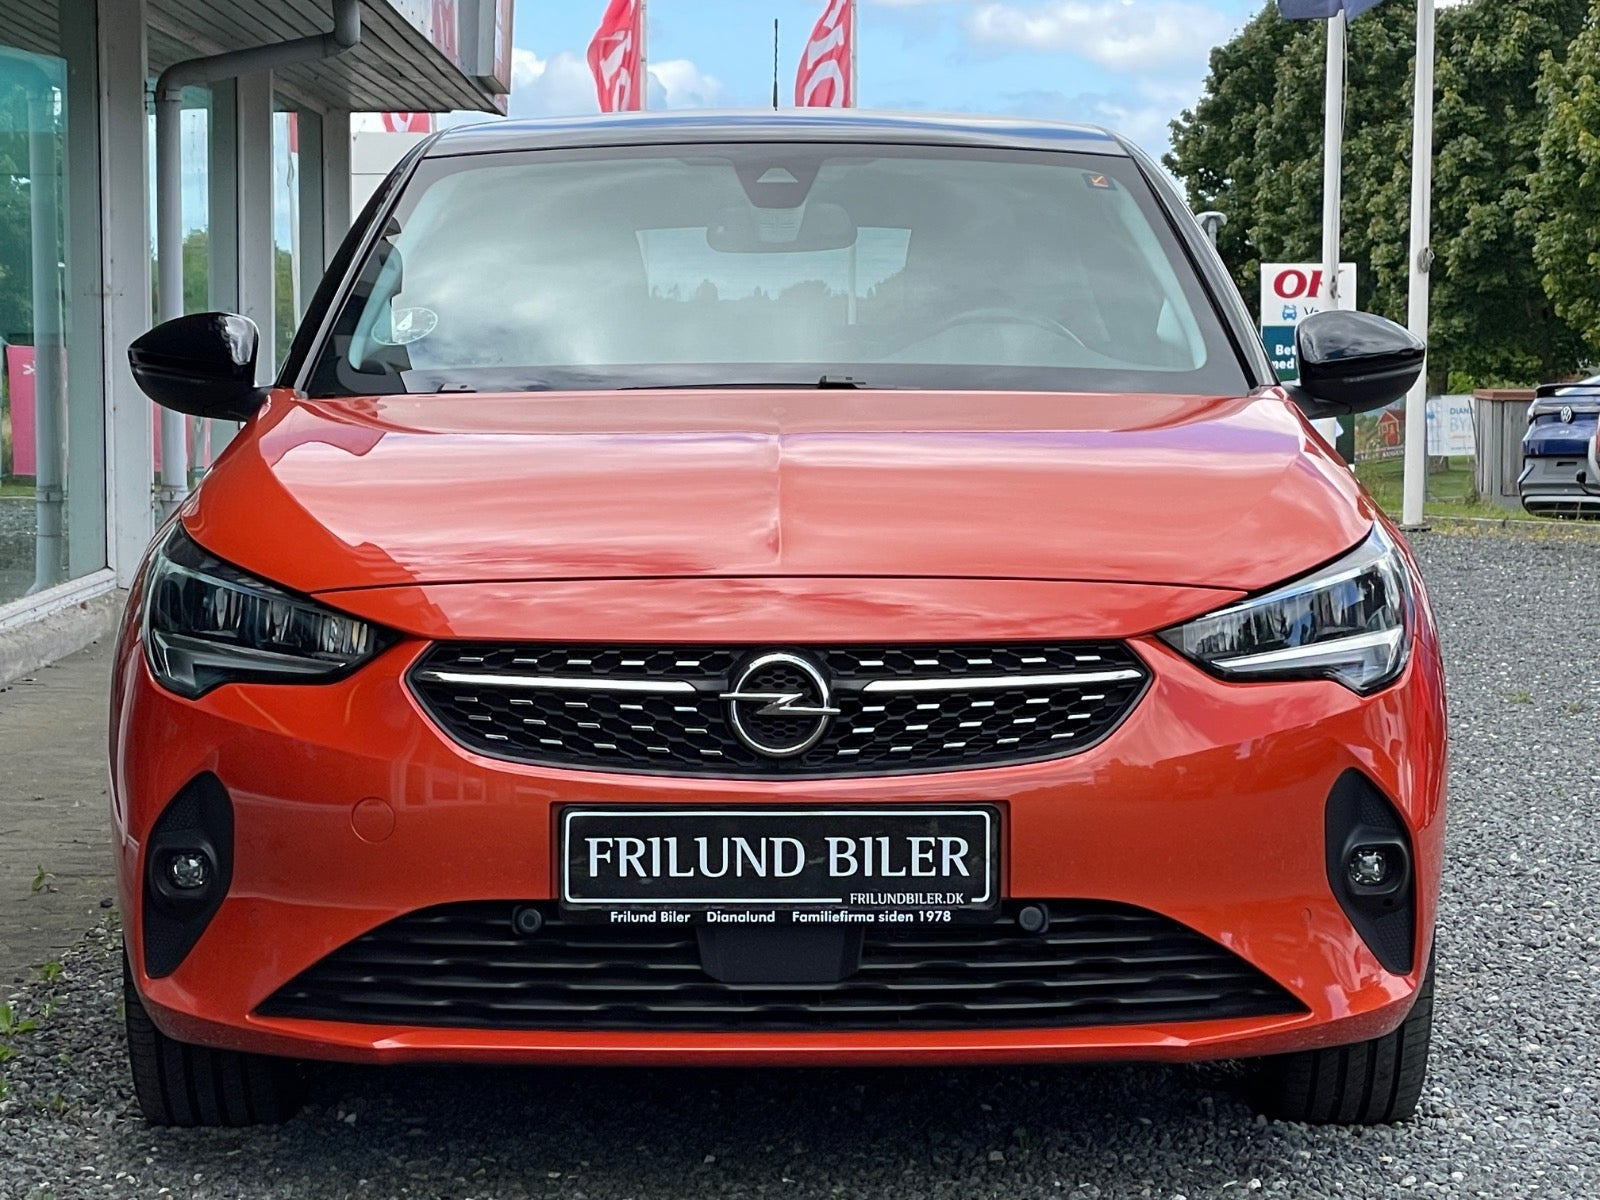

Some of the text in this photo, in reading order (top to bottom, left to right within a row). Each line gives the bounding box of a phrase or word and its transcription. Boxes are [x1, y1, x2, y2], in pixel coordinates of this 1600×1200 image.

[584, 836, 970, 878] FRILUND BILER
[850, 892, 965, 905] FRILUNDBILER.DK
[610, 910, 952, 923] Frilund Biler Dianalund Familiefirma siden 1978
